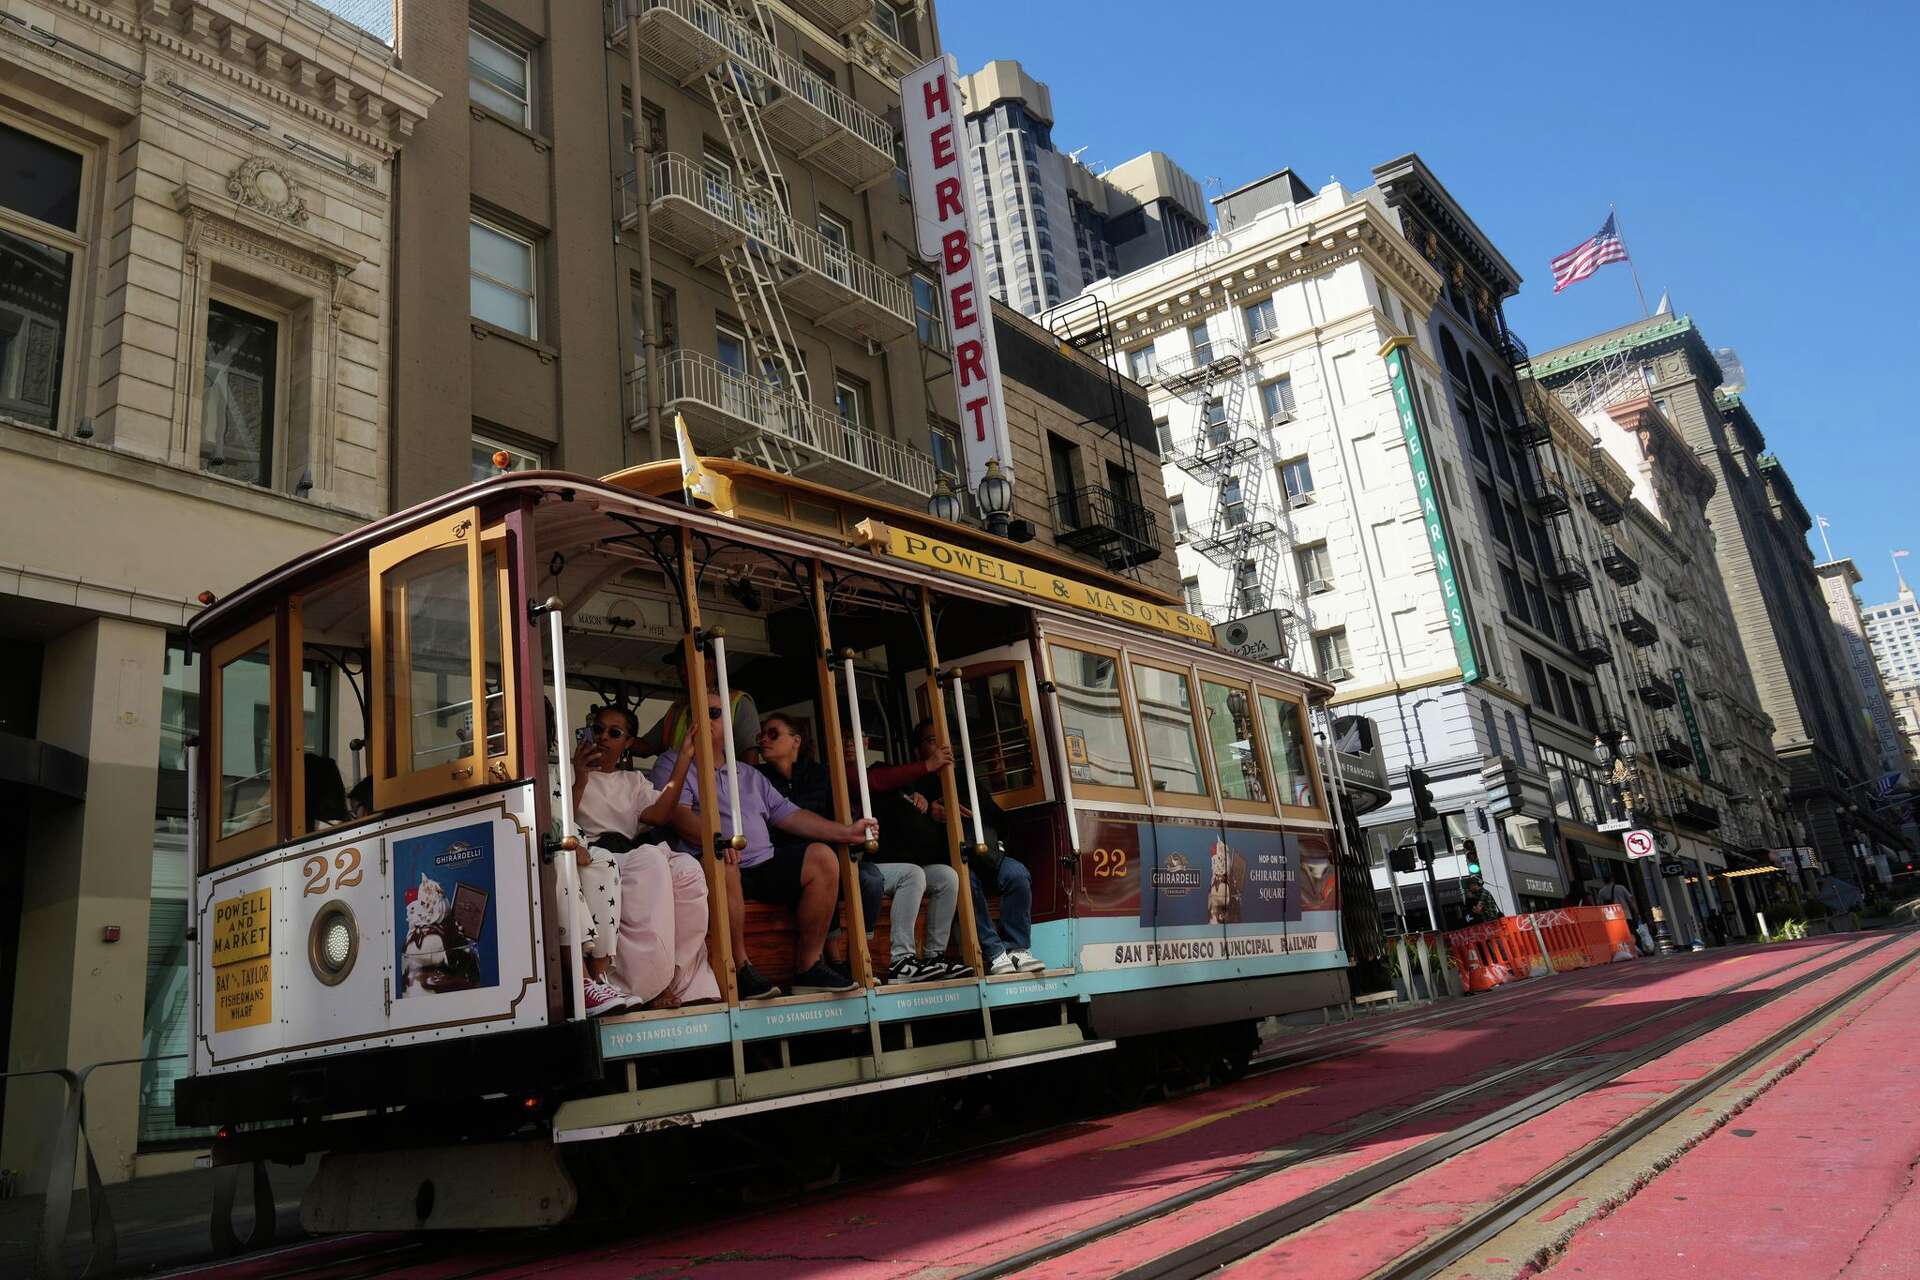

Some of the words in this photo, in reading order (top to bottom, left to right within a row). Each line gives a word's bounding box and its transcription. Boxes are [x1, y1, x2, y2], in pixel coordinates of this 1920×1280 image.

[923, 74, 988, 442] HERBERT
[1397, 386, 1420, 456] THE
[1417, 471, 1462, 626] BARNES
[905, 536, 1037, 590] POWELL
[1052, 579, 1071, 599] &
[1084, 587, 1170, 626] MASON
[435, 848, 481, 865] GHIRARDELLI
[1093, 849, 1128, 878] 22
[303, 847, 364, 898] 22
[1152, 872, 1200, 884] GHIRARDELLI
[217, 896, 266, 923] POWELL
[229, 917, 253, 932] AND
[214, 927, 267, 953] MARKET
[1115, 944, 1142, 963] SAN
[1146, 941, 1214, 962] FRANCISCO
[216, 973, 230, 992] BAY
[241, 965, 269, 986] TAYLOR
[231, 1005, 253, 1020] WHARF
[766, 1015, 784, 1024] TWO
[824, 1007, 843, 1017] ONLY
[609, 1033, 633, 1047] TWO
[685, 1023, 708, 1035] ONLY
